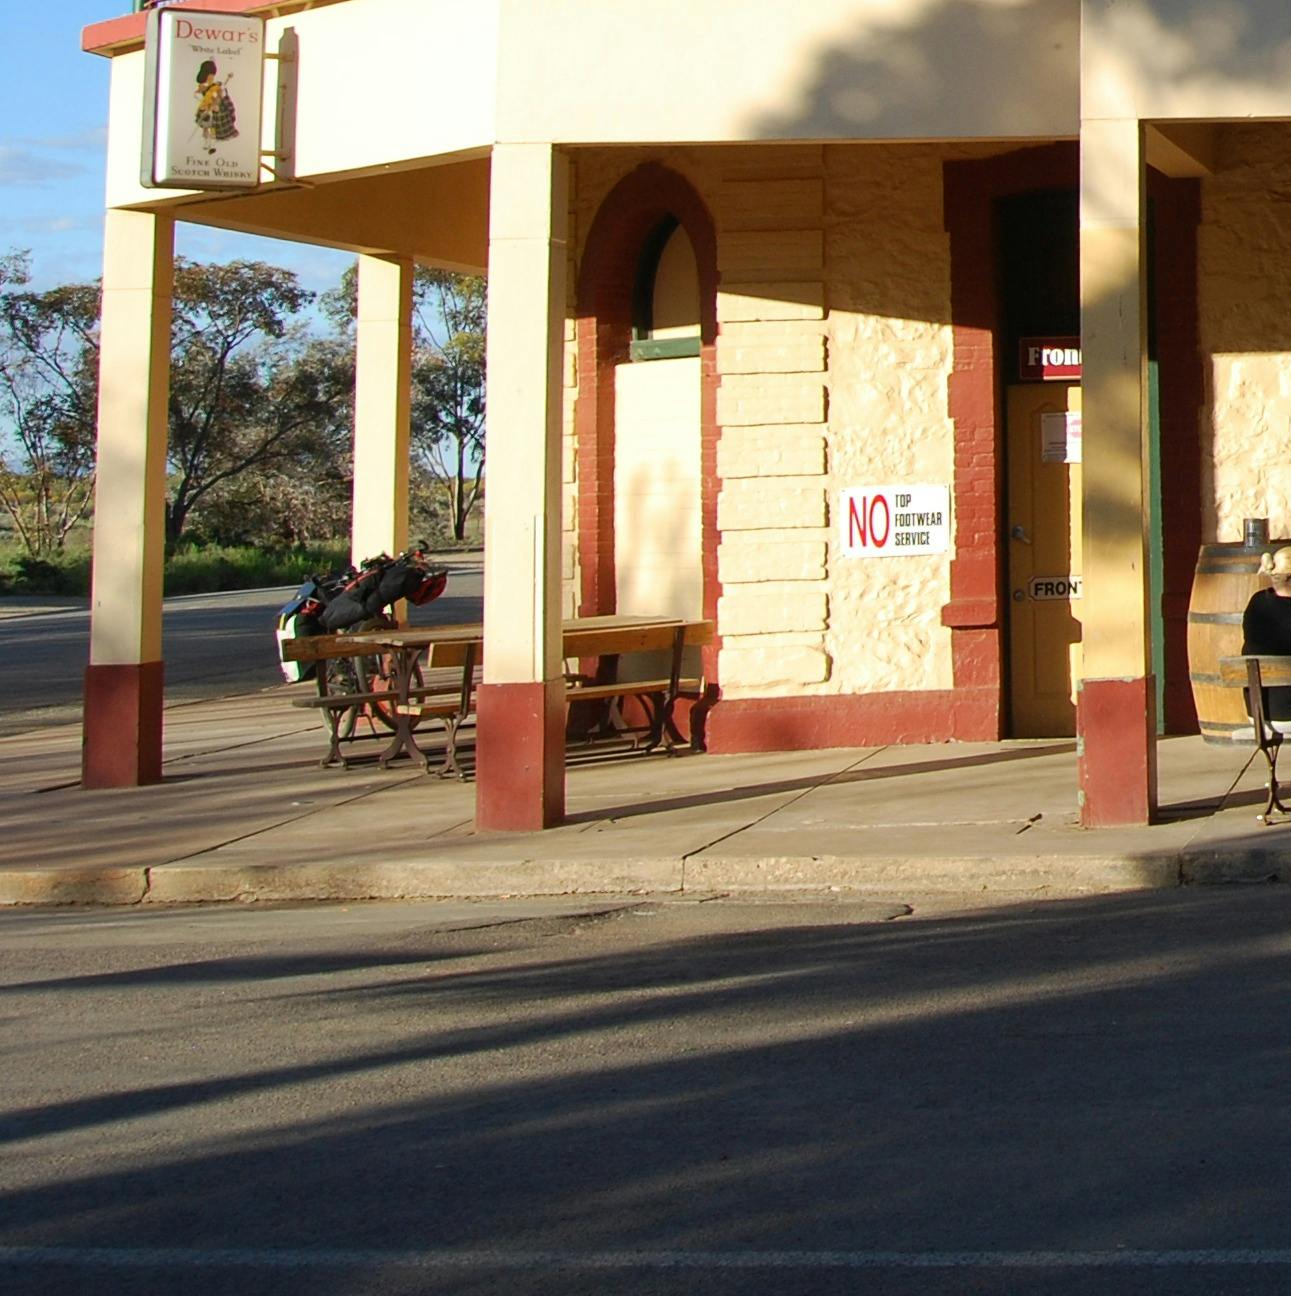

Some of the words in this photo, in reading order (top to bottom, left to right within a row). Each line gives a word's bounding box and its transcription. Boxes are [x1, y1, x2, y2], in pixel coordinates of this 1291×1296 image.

[175, 19, 259, 44] Dewar's
[1027, 346, 1082, 367] Fron
[895, 493, 912, 509] TOP
[849, 494, 890, 549] NO
[895, 511, 943, 528] FOOTWEAR
[895, 531, 931, 547] SERVICE
[1033, 579, 1082, 596] FRON
